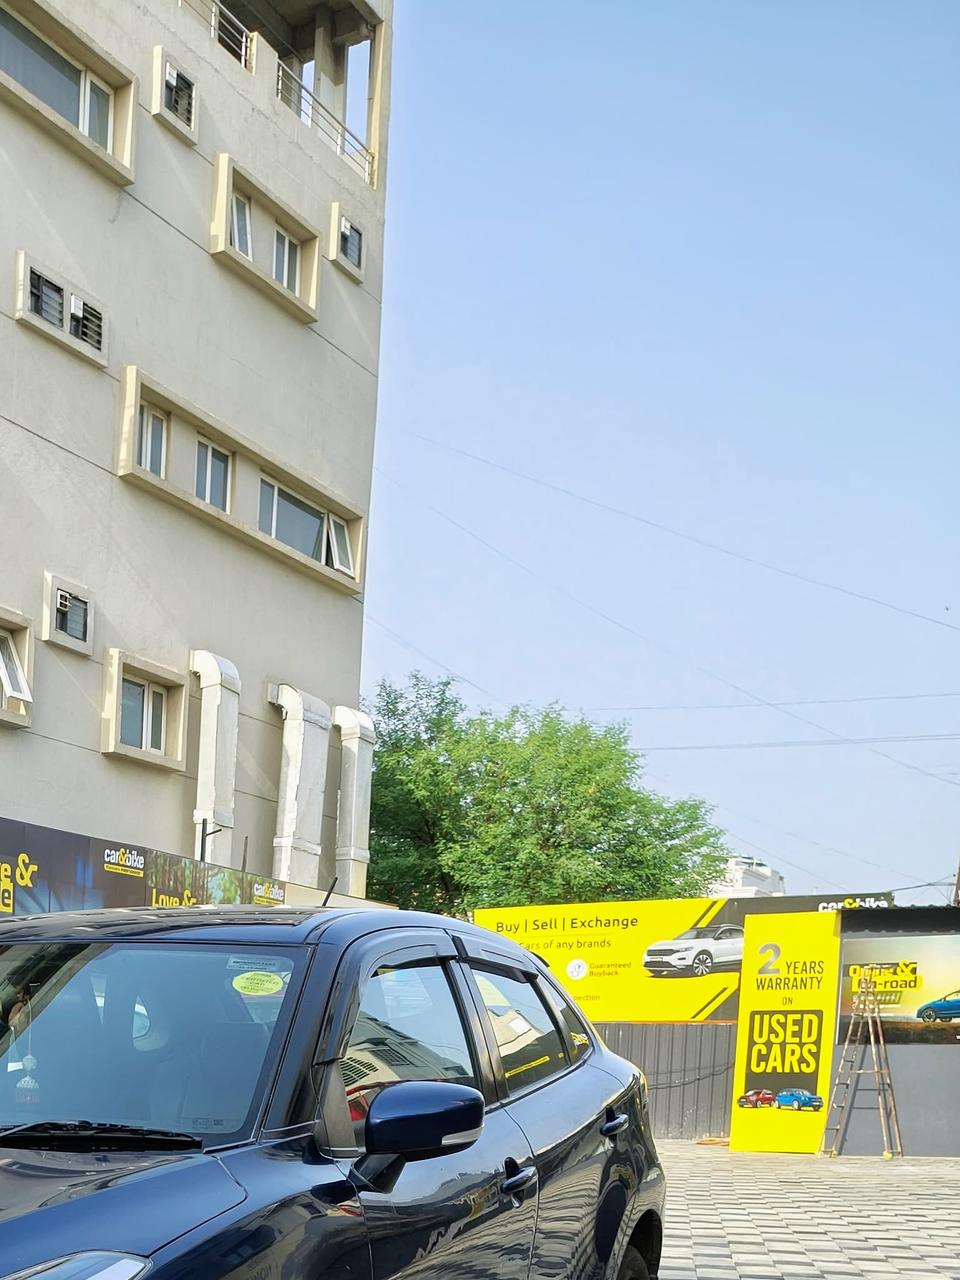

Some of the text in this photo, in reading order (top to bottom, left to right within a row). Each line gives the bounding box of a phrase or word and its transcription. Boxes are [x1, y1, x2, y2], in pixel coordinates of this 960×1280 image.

[104, 848, 145, 869] car&bike
[16, 853, 38, 888] &
[151, 888, 180, 908] Love
[496, 921, 520, 934] Buy
[532, 918, 558, 930] Sell
[570, 915, 639, 930] Exchange
[543, 940, 555, 949] of
[555, 940, 574, 951] any
[576, 939, 612, 949] brands
[757, 943, 825, 975] 2 YEARS
[896, 959, 917, 977] &
[755, 976, 824, 991] WARRANTY
[782, 996, 793, 1006] ON
[752, 1013, 819, 1044] USED
[750, 1043, 818, 1074] CARS
